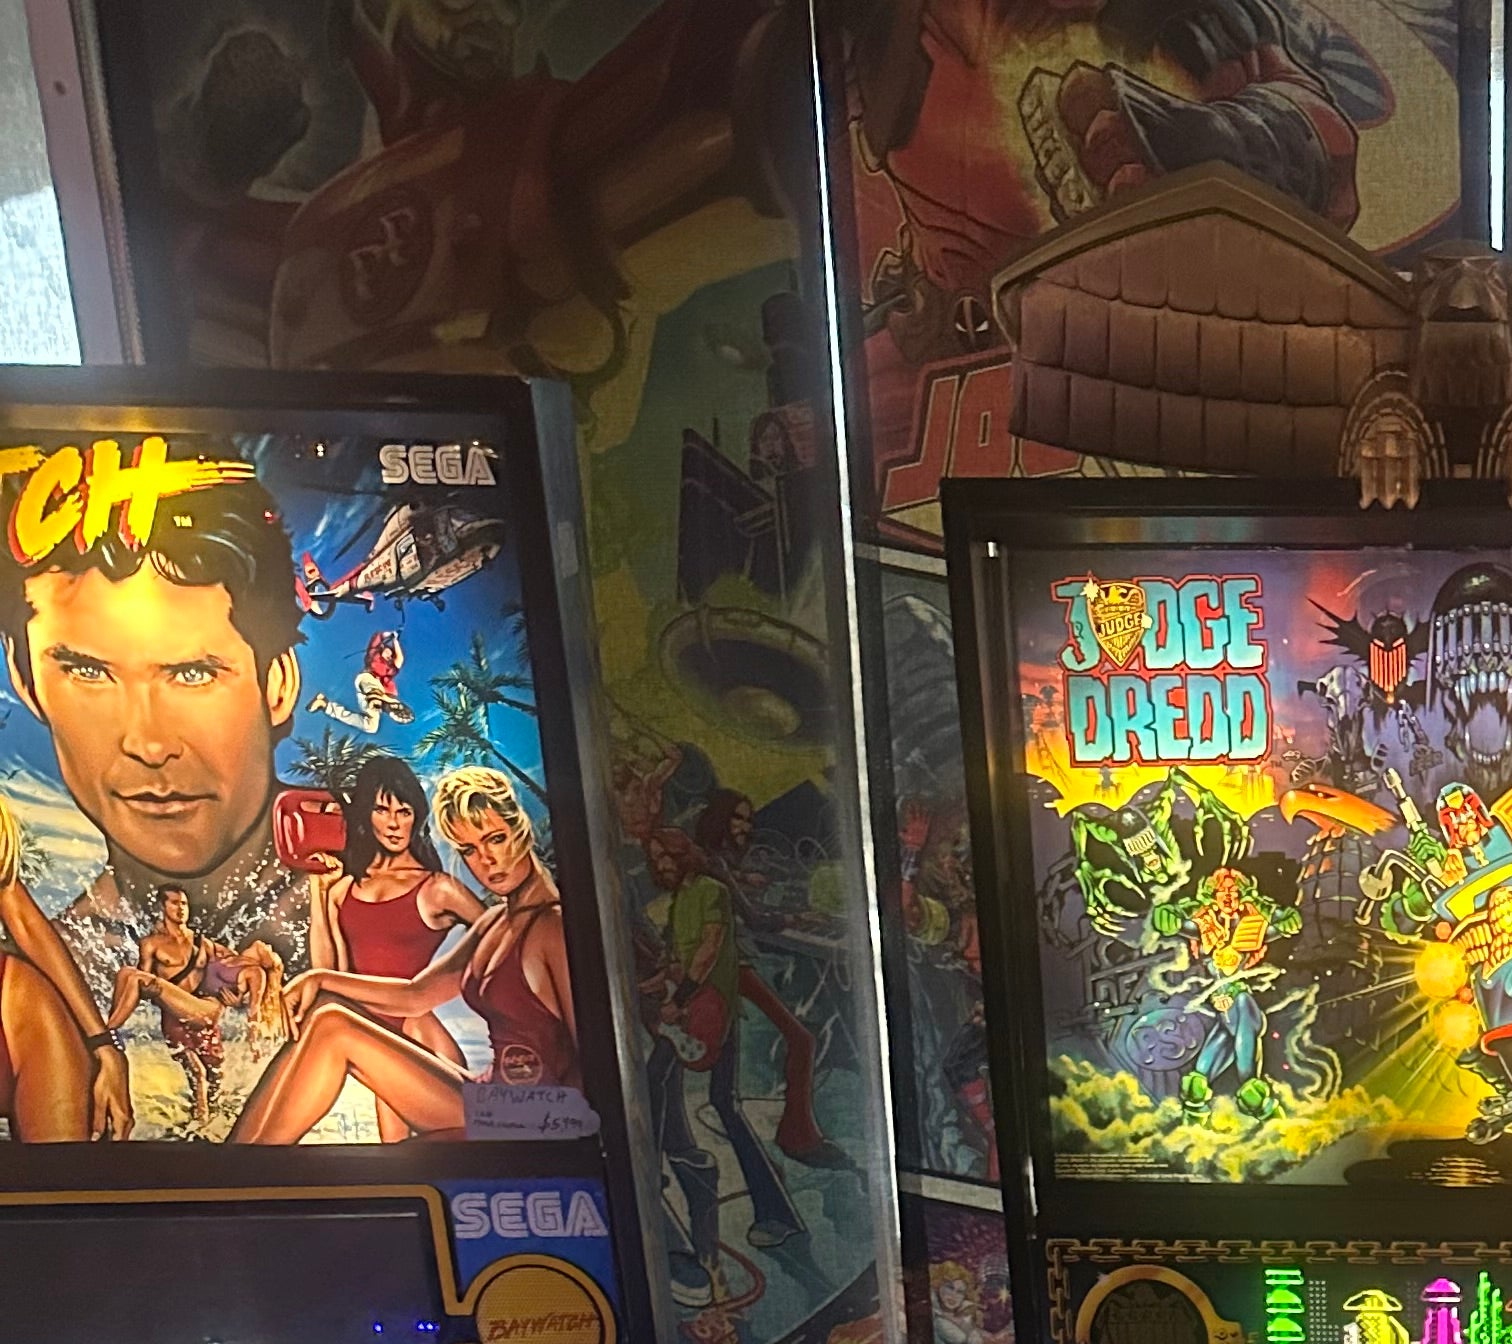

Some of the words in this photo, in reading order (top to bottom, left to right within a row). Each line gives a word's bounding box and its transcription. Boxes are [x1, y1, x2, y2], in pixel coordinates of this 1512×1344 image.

[379, 444, 498, 486] SEGA
[1053, 574, 1266, 672] JDGE
[1098, 612, 1144, 638] JUDGE
[1064, 673, 1272, 766] DREDD
[450, 1191, 609, 1240] SEGA
[486, 1311, 602, 1343] BAYWATCH
